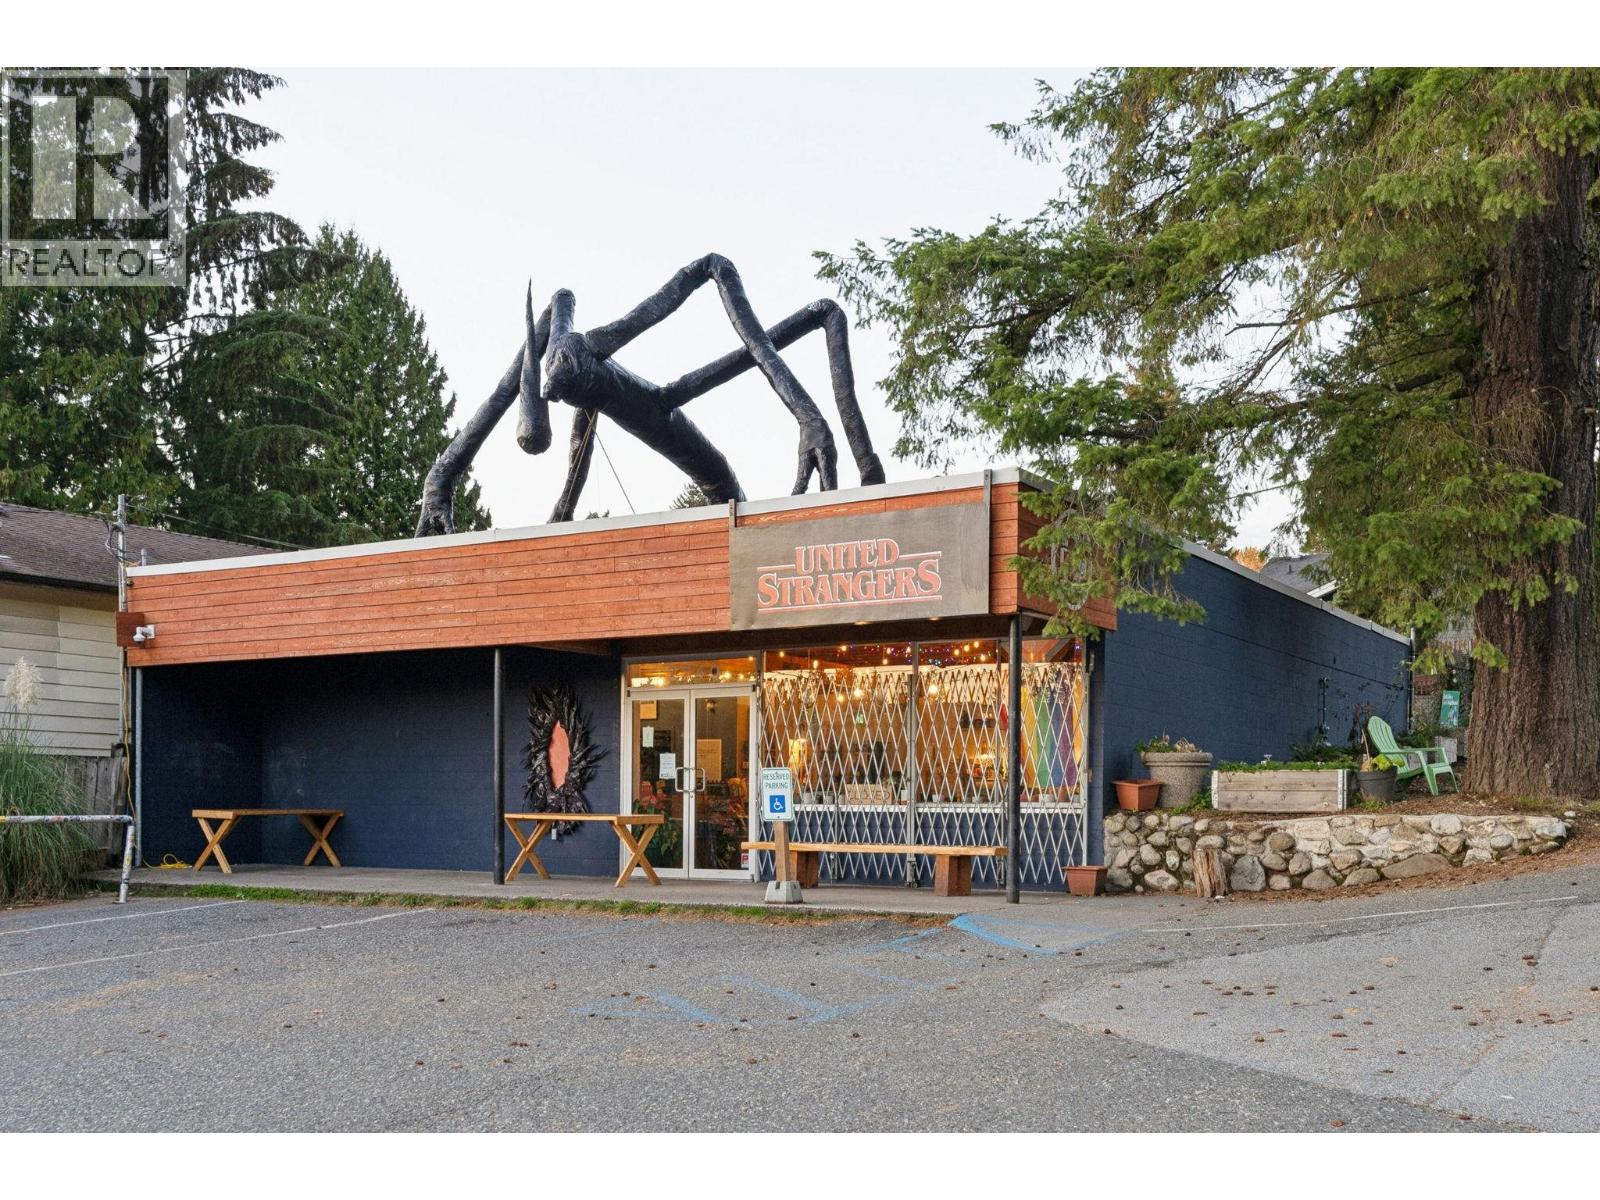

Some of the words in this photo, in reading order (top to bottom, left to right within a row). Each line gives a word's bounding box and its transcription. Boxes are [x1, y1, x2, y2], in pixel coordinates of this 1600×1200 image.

[795, 538, 900, 575] UNITED
[757, 559, 942, 607] STRANGERS
[763, 773, 789, 781] RESERVED
[848, 789, 891, 801] CLOSED
